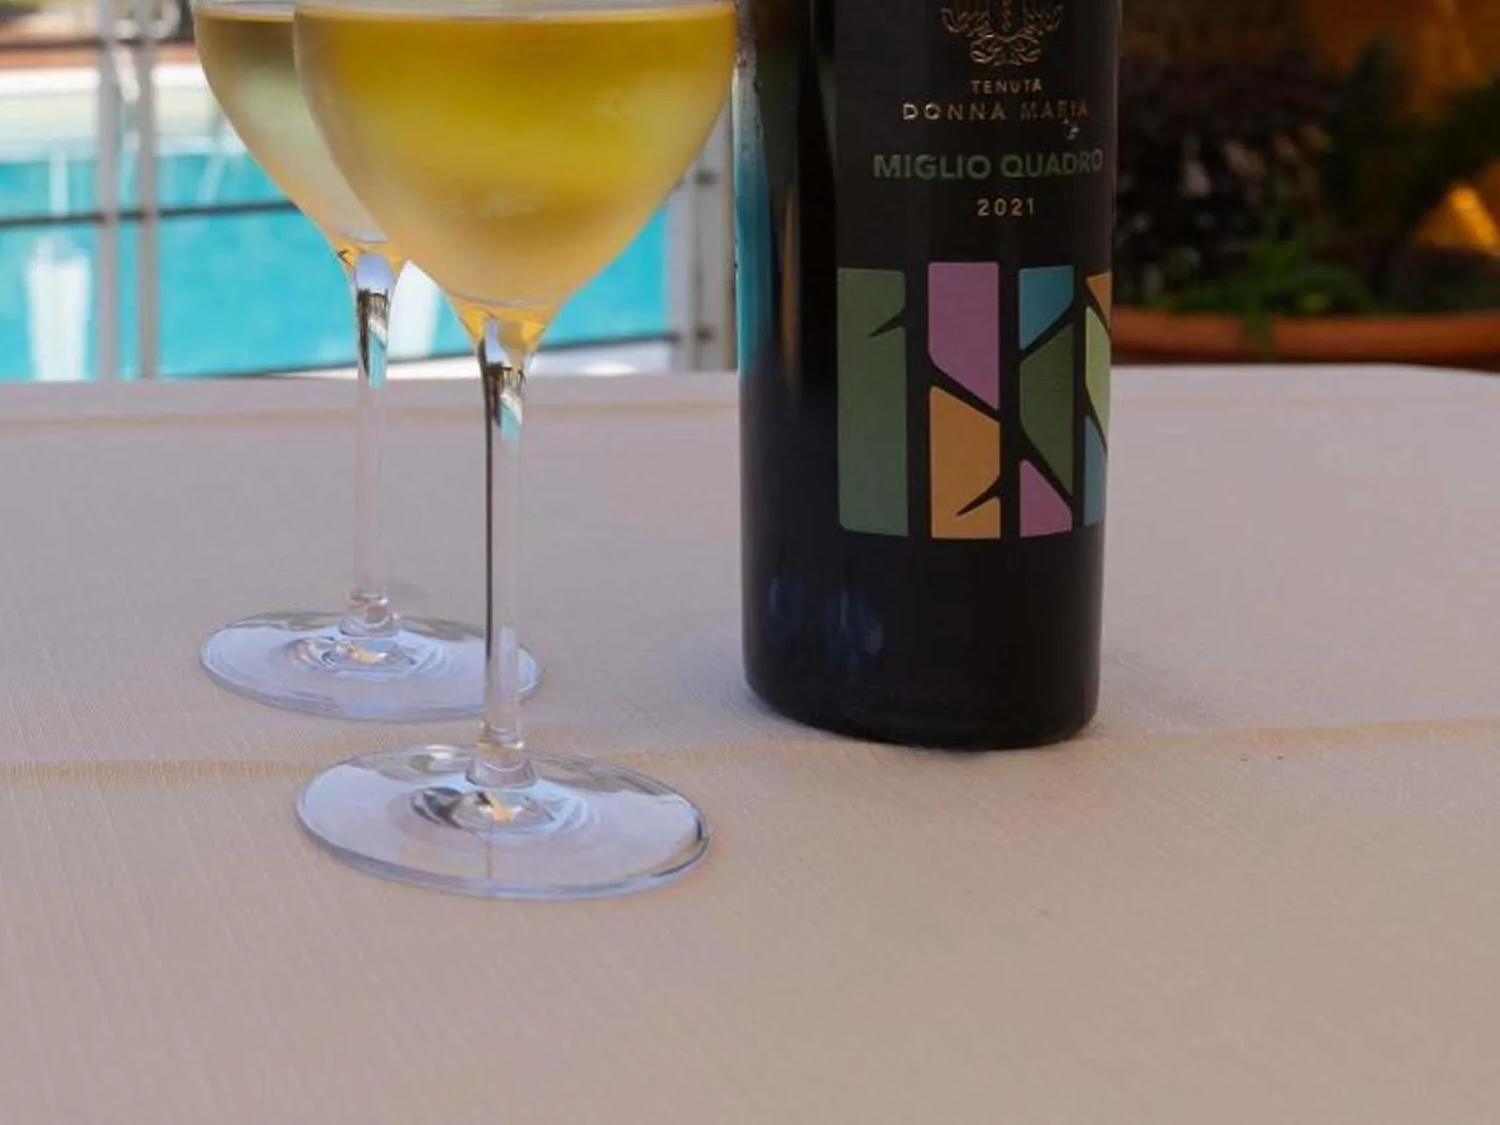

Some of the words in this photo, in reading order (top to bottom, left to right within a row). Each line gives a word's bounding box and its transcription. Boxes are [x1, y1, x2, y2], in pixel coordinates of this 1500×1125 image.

[970, 78, 1043, 94] TENUTA
[902, 102, 1007, 121] DONNA
[873, 154, 992, 179] MIGLIO
[999, 148, 1104, 178] QUADRO
[977, 197, 1035, 217] 2021
